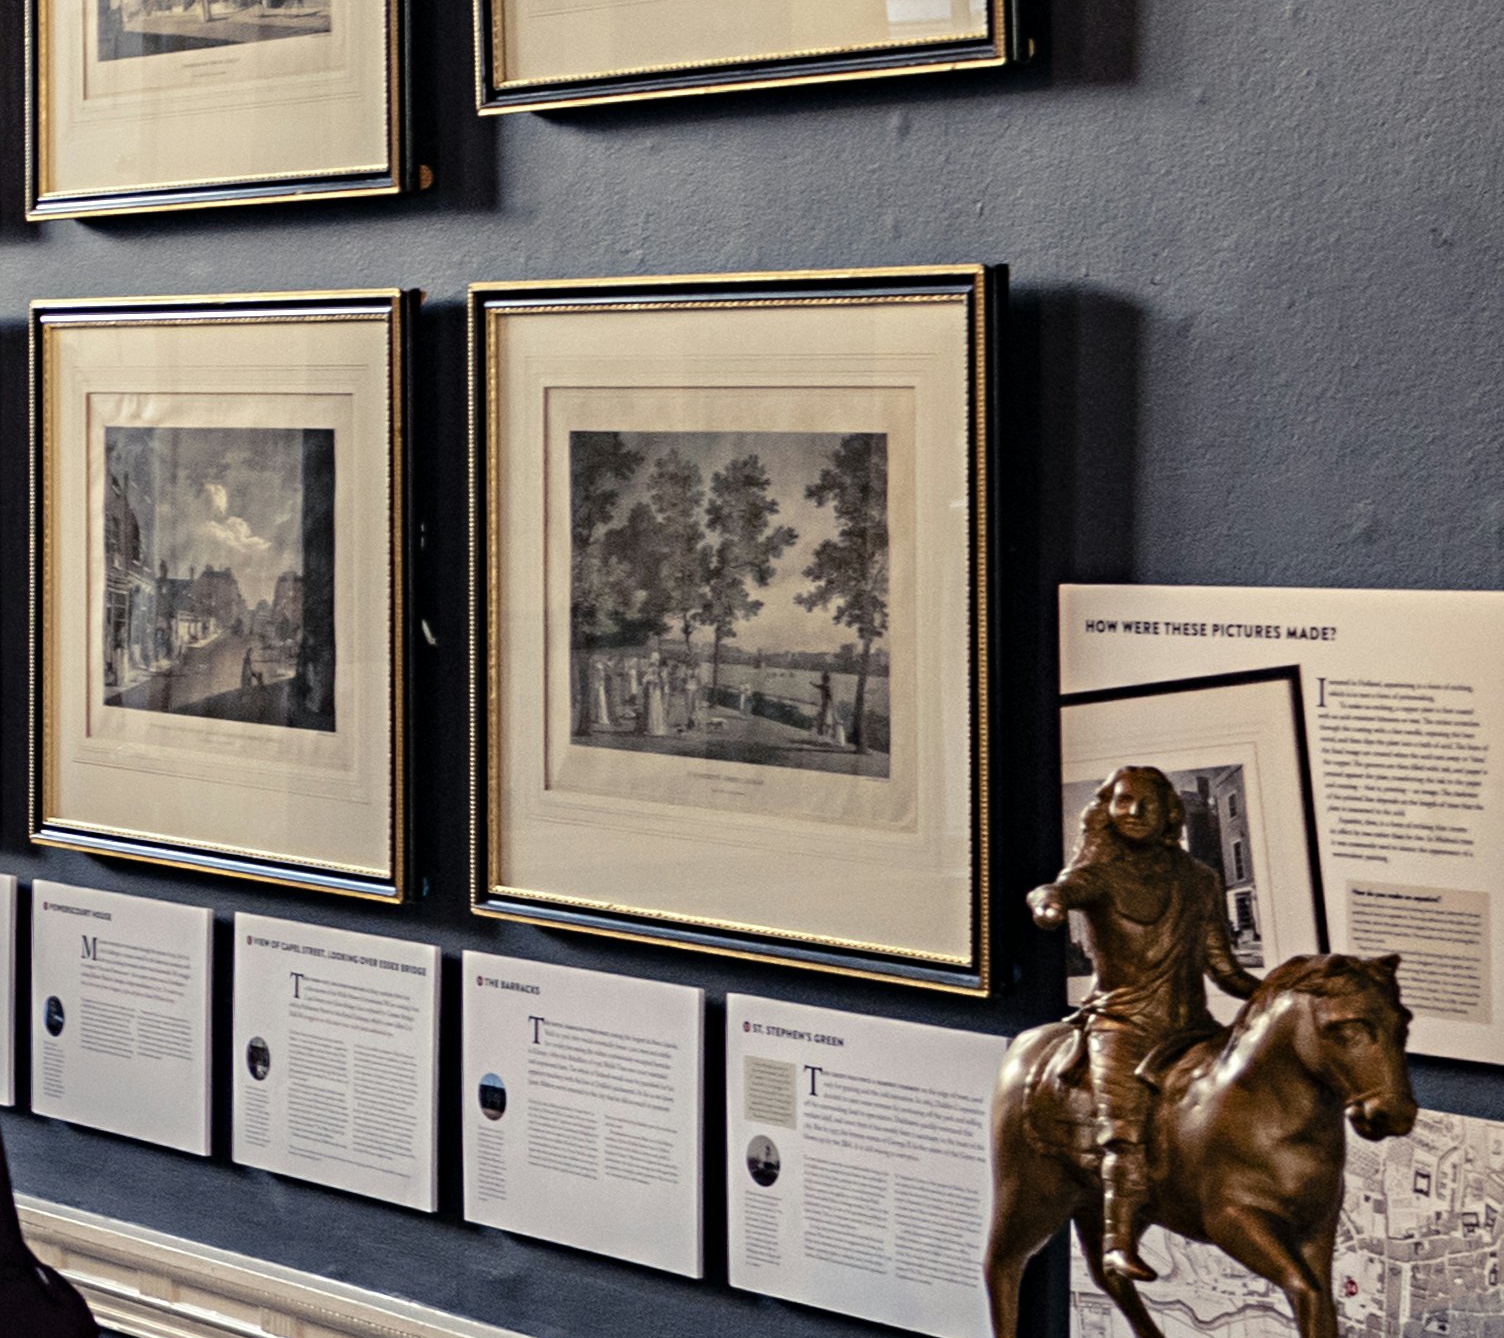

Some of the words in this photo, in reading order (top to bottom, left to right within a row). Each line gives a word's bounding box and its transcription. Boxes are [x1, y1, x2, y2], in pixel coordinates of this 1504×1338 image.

[1085, 619, 1117, 633] HOW
[1122, 621, 1160, 635] WERE
[1164, 622, 1207, 637] THESE
[1212, 623, 1281, 640] PICTURES
[1287, 627, 1337, 641] MADE?
[360, 956, 378, 968] OVER
[400, 963, 426, 976] BRIDGE
[484, 977, 499, 989] THE
[500, 980, 541, 996] BARRACKS
[752, 1023, 764, 1035] ST.
[766, 1026, 812, 1043] STEPHEN'S
[814, 1034, 844, 1047] GREEN
